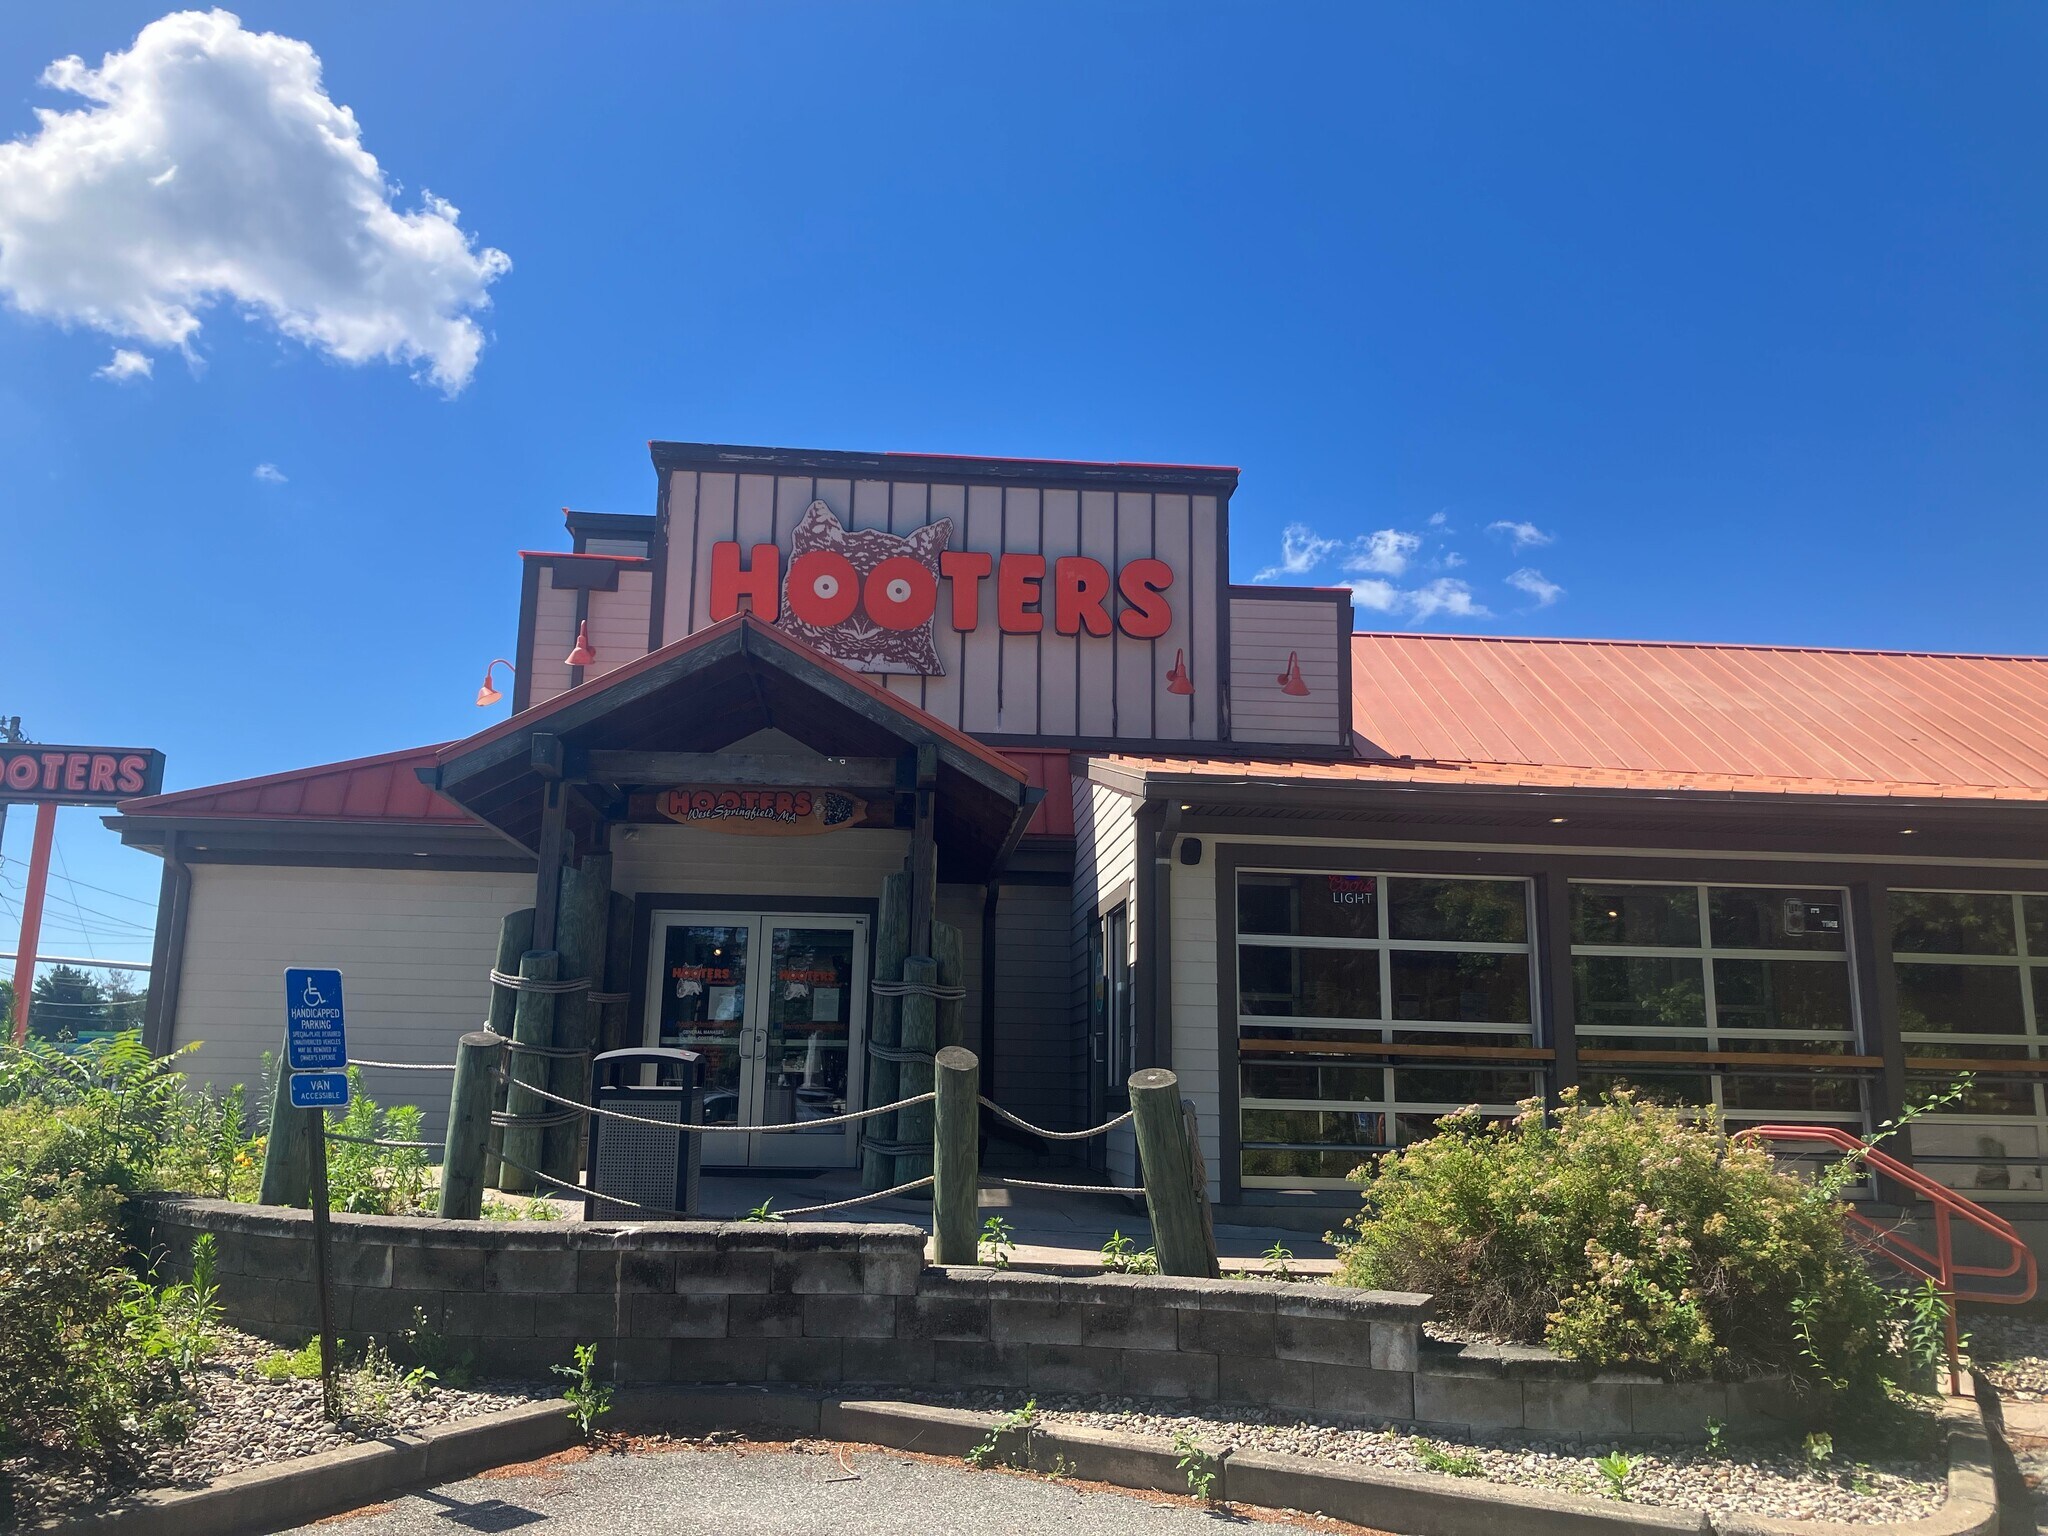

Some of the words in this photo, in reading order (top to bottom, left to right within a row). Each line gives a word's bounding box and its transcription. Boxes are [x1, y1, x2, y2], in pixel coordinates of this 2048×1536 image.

[709, 541, 1175, 639] HOOTERS
[0, 752, 147, 792] OTERS
[668, 790, 814, 817] HOOTERS
[687, 808, 711, 820] West
[776, 810, 797, 823] MA
[1333, 892, 1373, 904] LIGHT
[672, 967, 730, 979] HOOTERS
[291, 1008, 340, 1018] HANDICAPPED
[301, 1020, 332, 1030] PARKING
[310, 1081, 330, 1091] VAN
[301, 1092, 340, 1100] ACCESSIBLE
